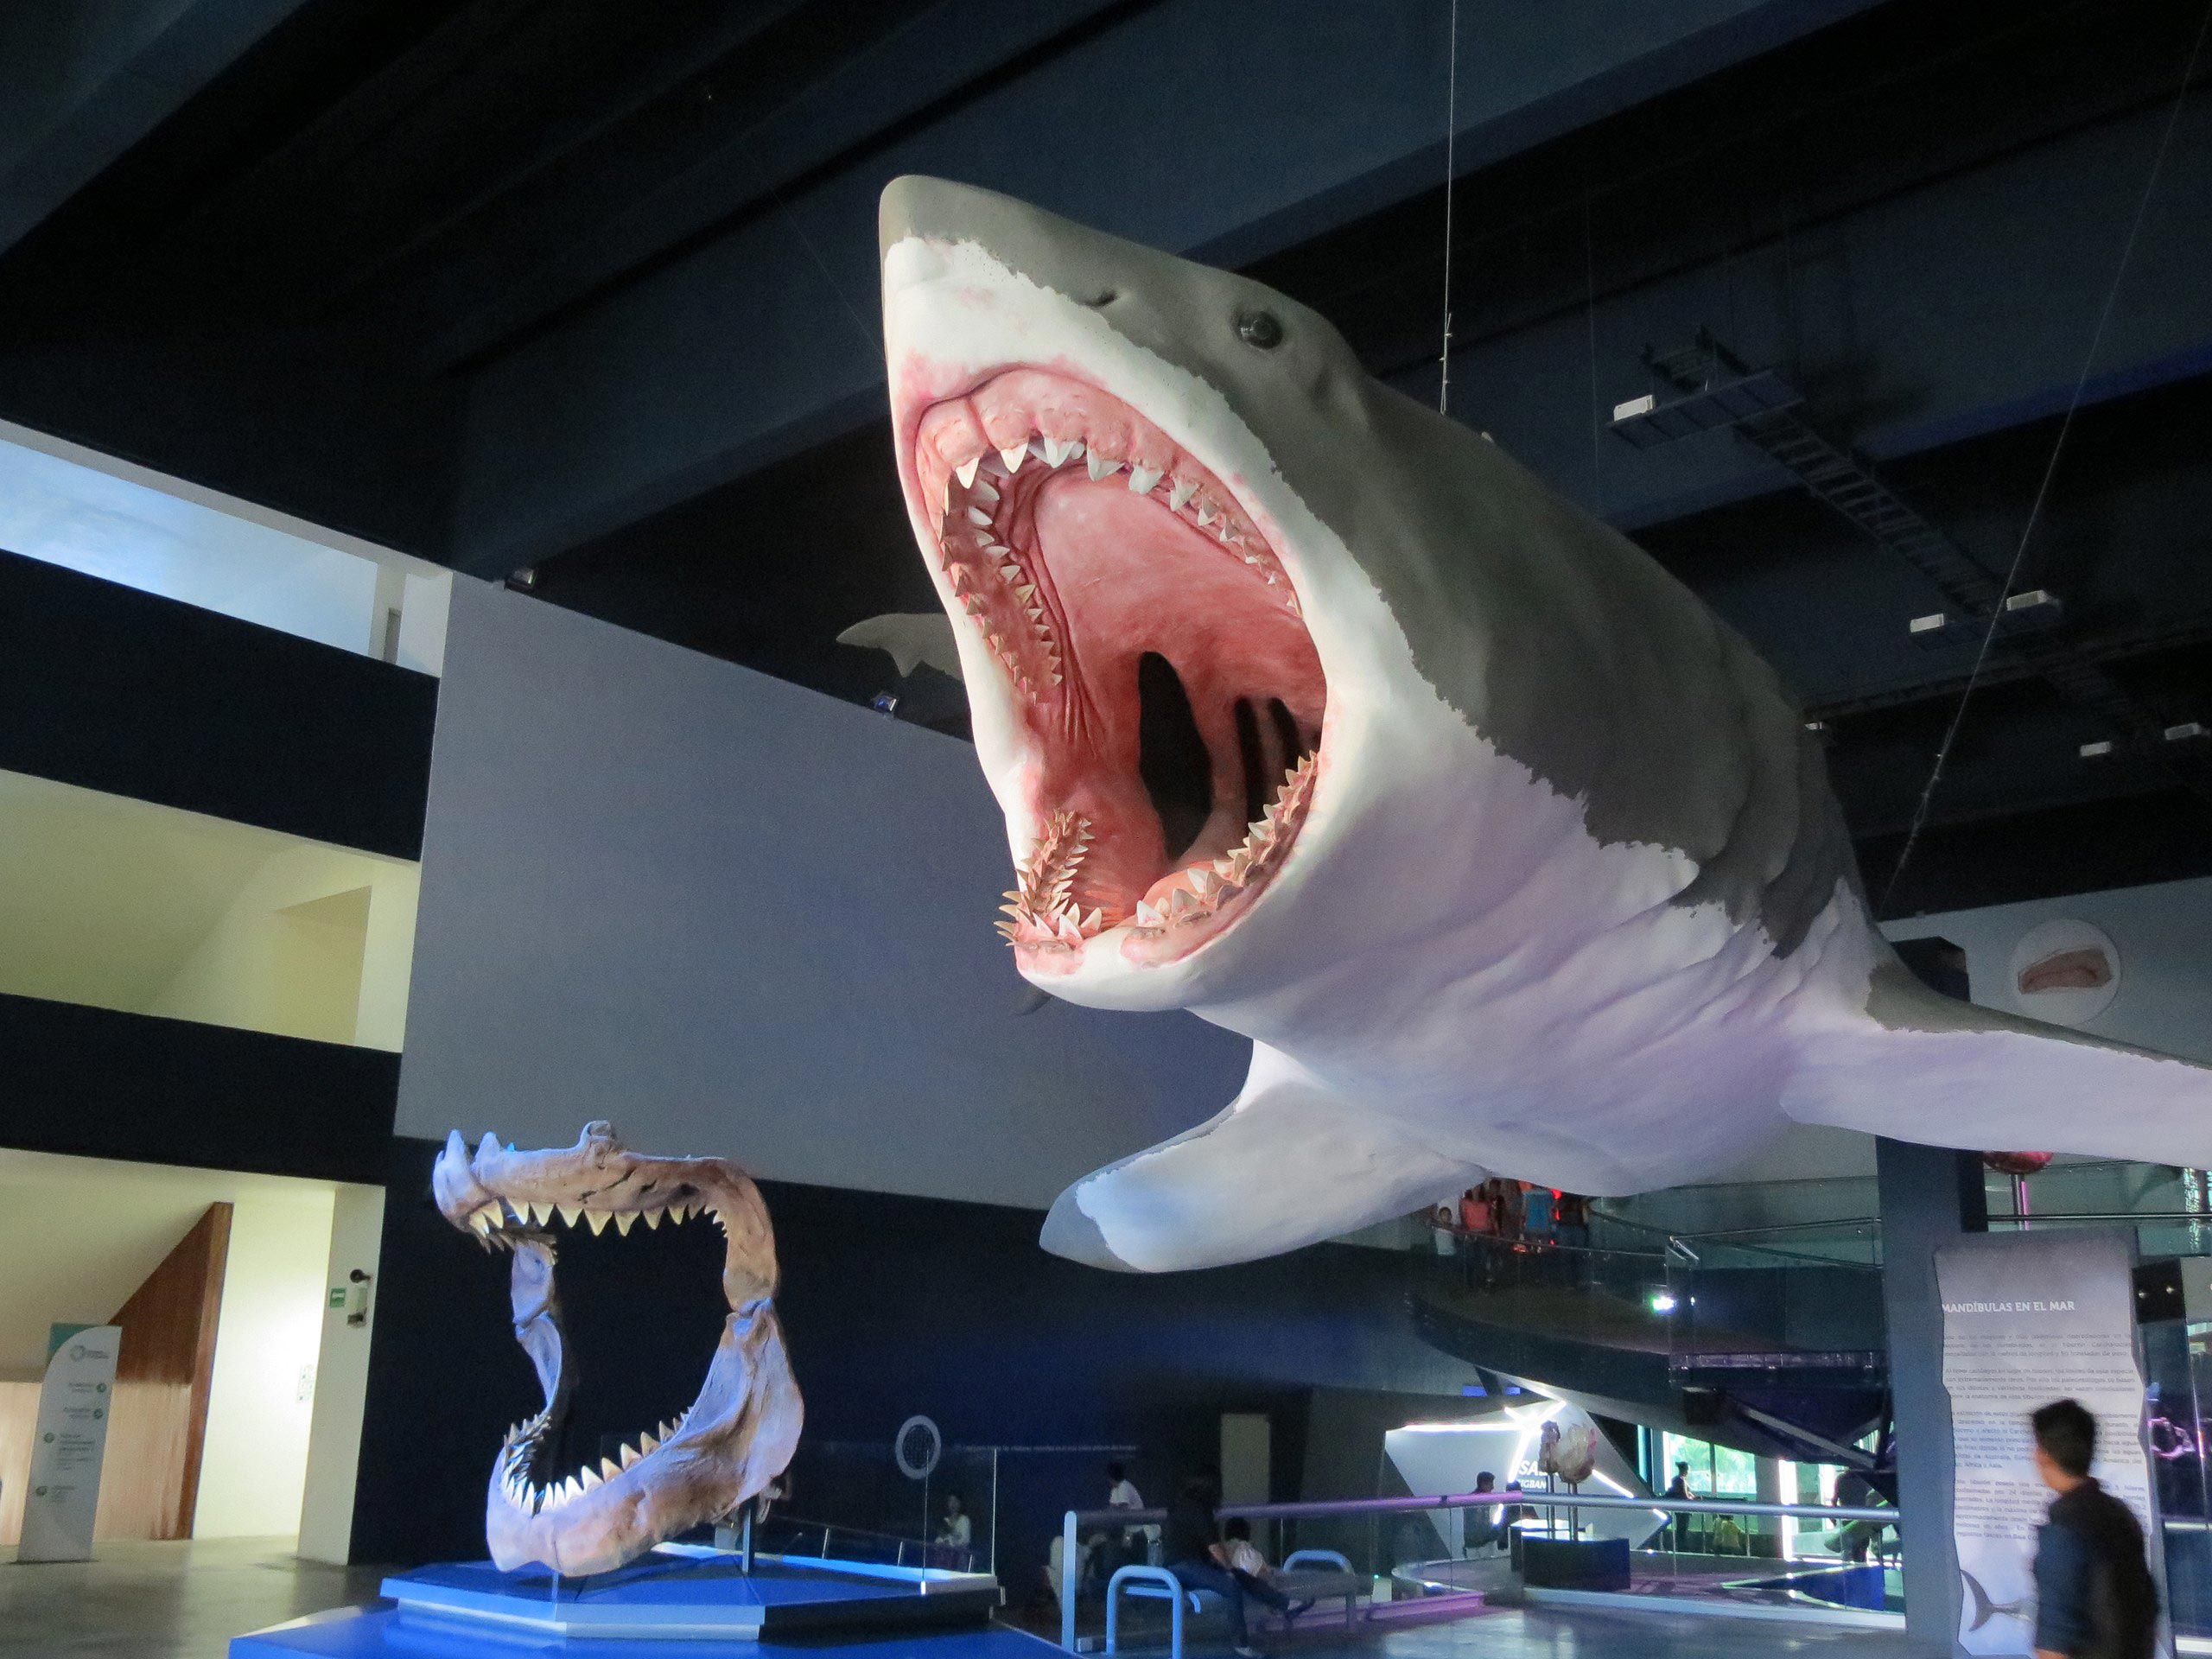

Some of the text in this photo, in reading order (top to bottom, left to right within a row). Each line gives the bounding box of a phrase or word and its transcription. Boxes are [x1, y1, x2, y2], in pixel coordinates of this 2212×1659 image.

[1942, 1300, 2075, 1313] MANDÍBULAS EN EL MAR
